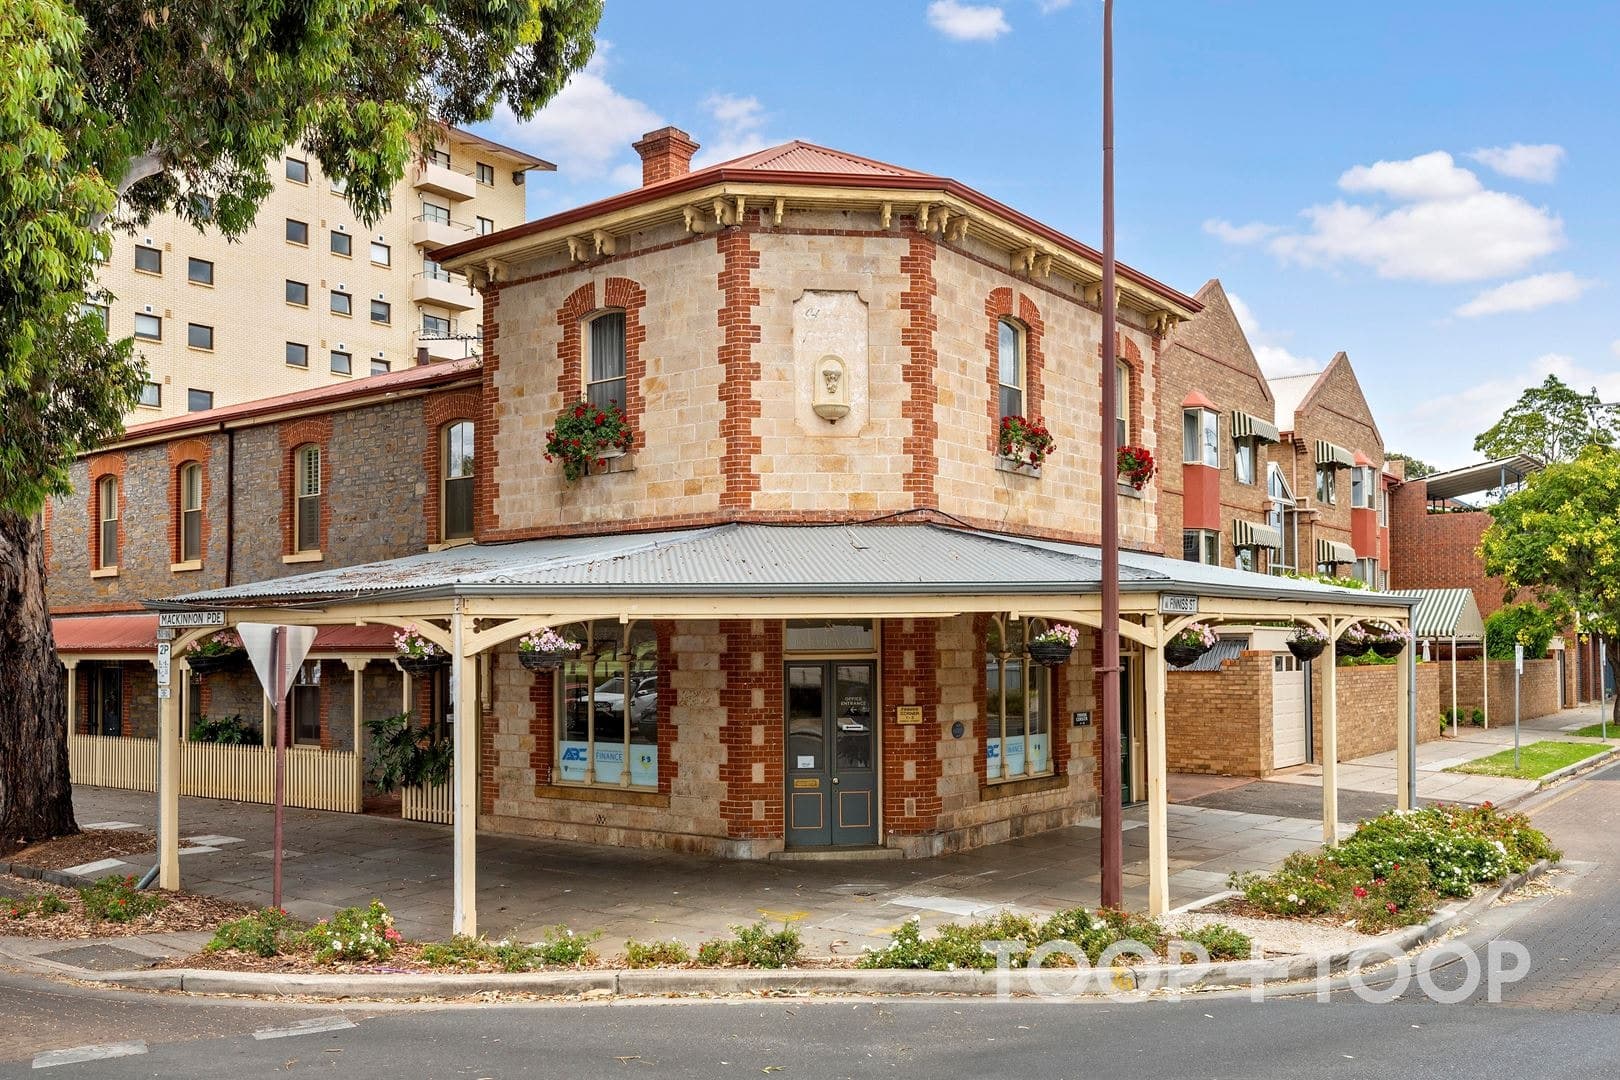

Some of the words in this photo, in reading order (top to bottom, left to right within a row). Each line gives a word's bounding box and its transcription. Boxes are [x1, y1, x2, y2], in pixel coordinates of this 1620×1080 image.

[161, 613, 204, 625] MACKINNON
[159, 644, 169, 655] 2P
[562, 747, 588, 761] ABC
[595, 751, 623, 761] FINANCE
